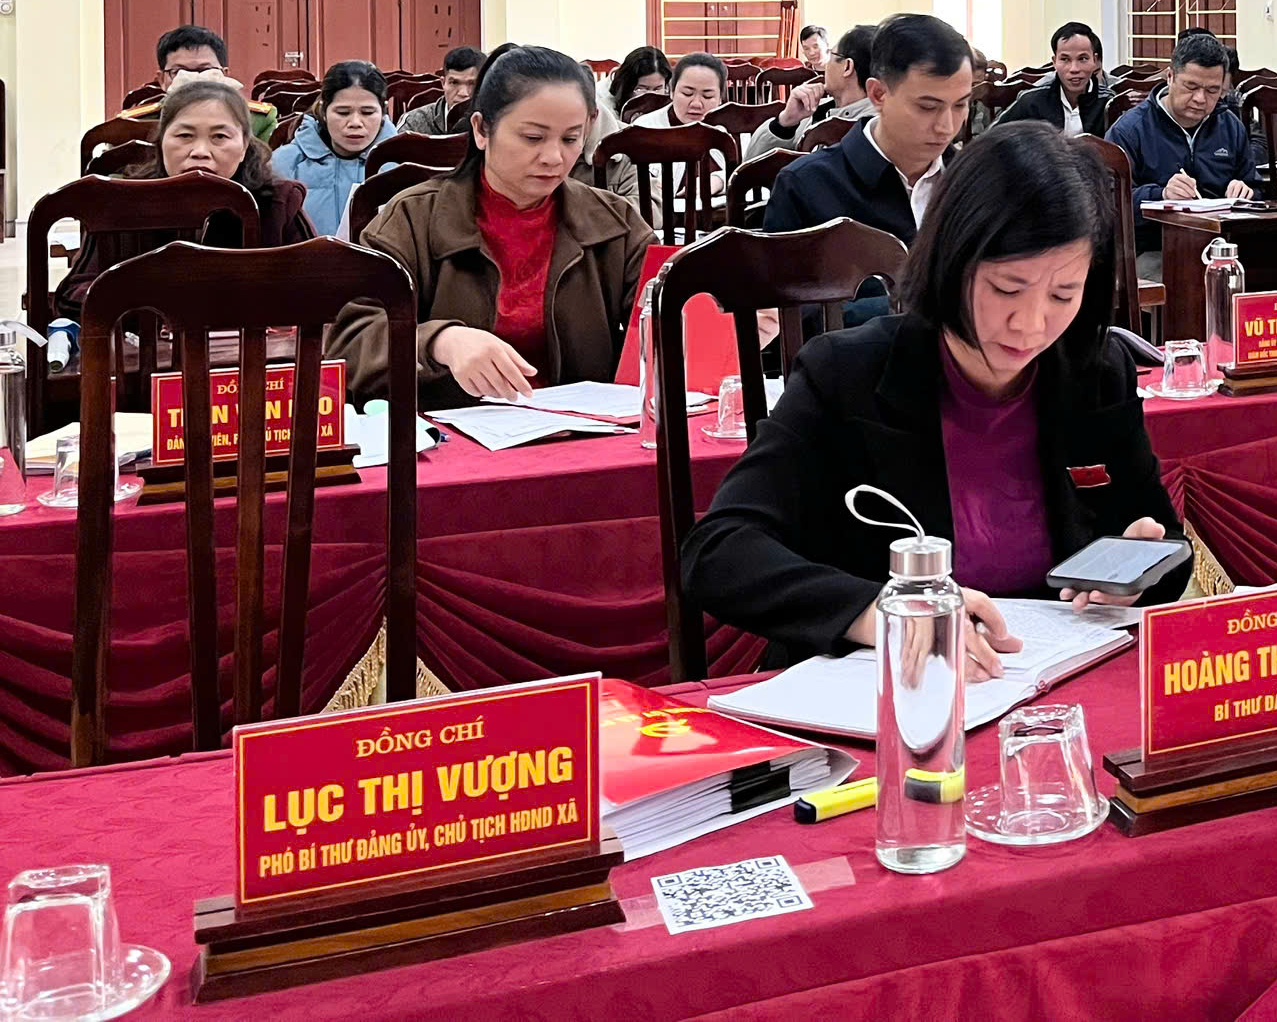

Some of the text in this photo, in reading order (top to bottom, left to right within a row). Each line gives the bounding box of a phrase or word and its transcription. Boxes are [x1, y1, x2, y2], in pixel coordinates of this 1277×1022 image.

[1164, 650, 1250, 696] HOÀNG
[1214, 699, 1230, 722] BÍ
[1233, 697, 1262, 719] THƯ
[355, 715, 485, 758] ĐỒNG CHÍ
[263, 745, 574, 836] LỤC THỊ VƯỢNG
[259, 796, 579, 878] PHÓ BÍ THƯ ĐẢNG ỦY, CHỦ TỊCH HĐND XÃ
